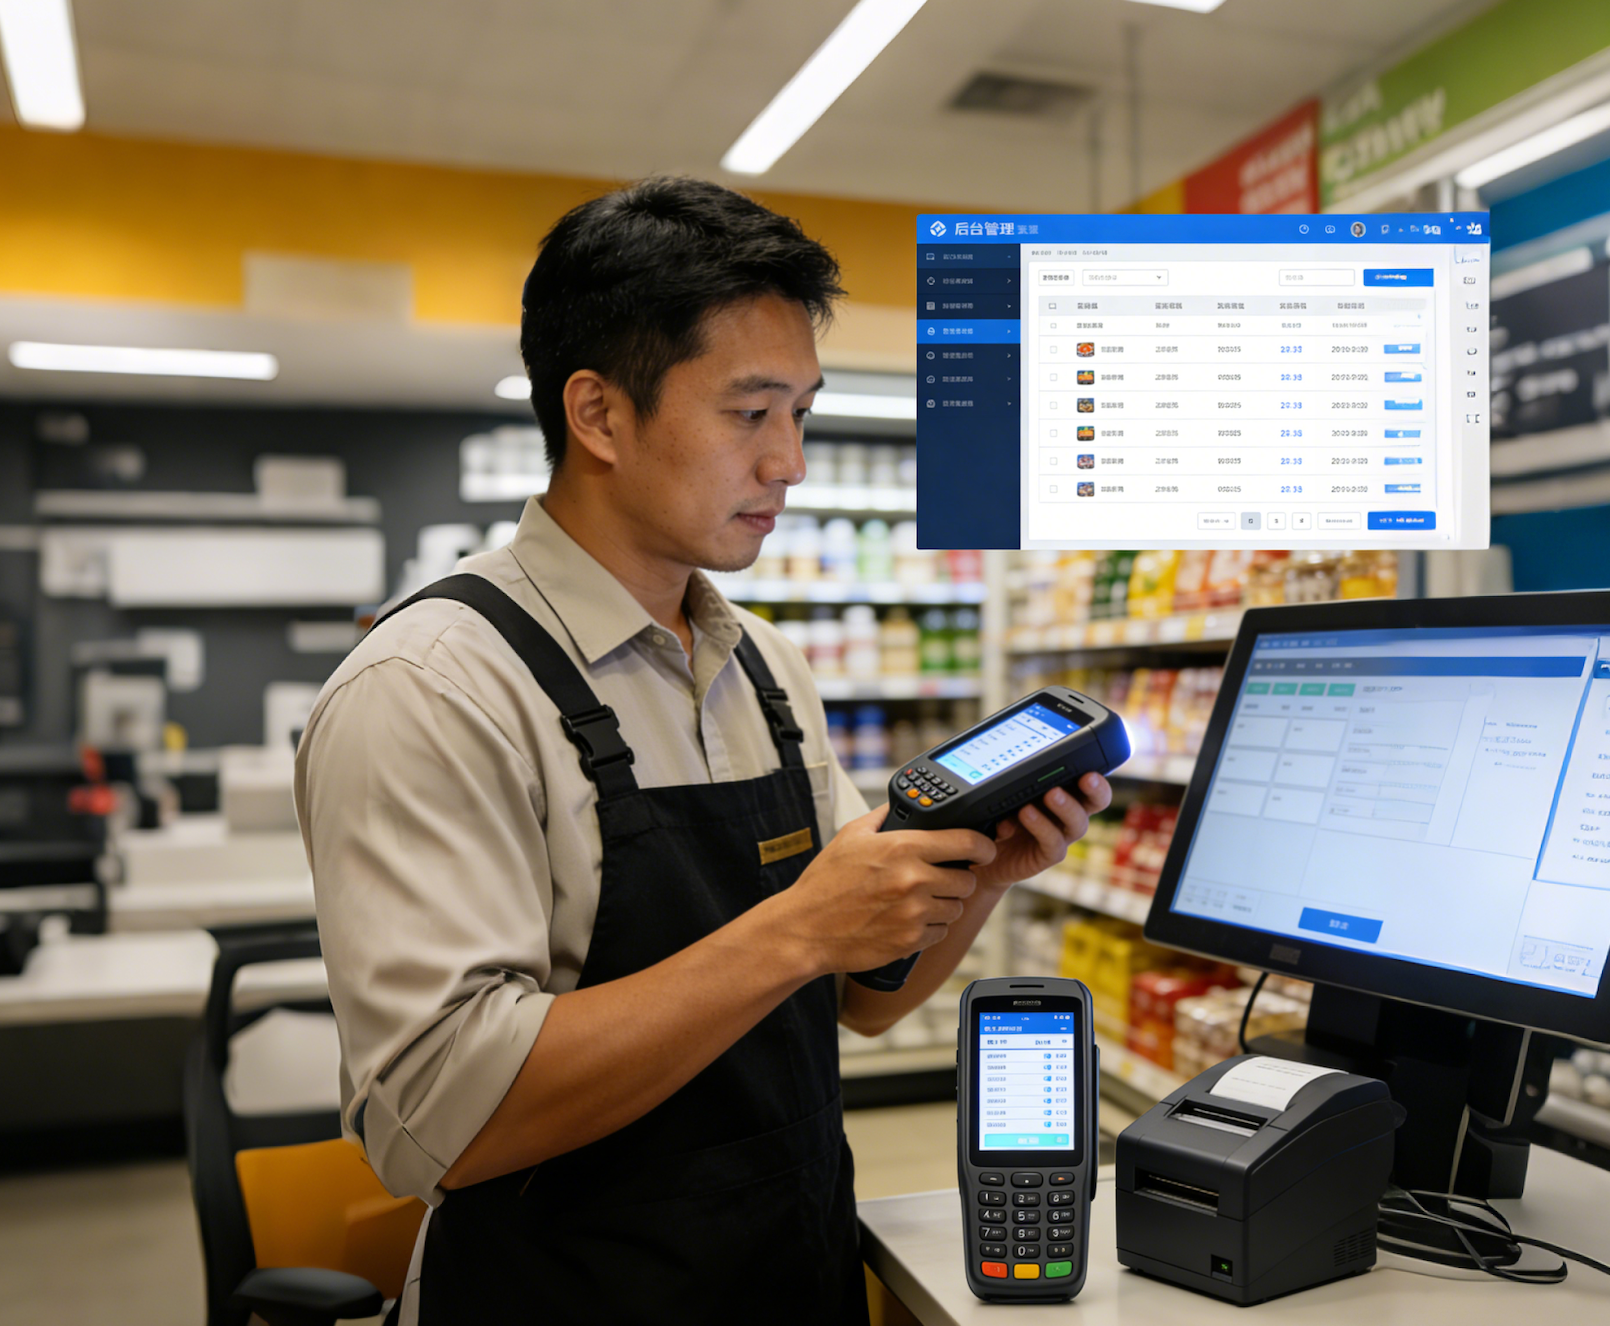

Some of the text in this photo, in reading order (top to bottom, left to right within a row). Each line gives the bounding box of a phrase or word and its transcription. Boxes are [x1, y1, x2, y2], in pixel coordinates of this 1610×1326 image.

[956, 222, 1014, 236] 后台管理
[1018, 1210, 1026, 1221] 5
[1052, 1211, 1060, 1220] 6
[982, 1227, 991, 1238] 7
[1018, 1246, 1026, 1256] 0
